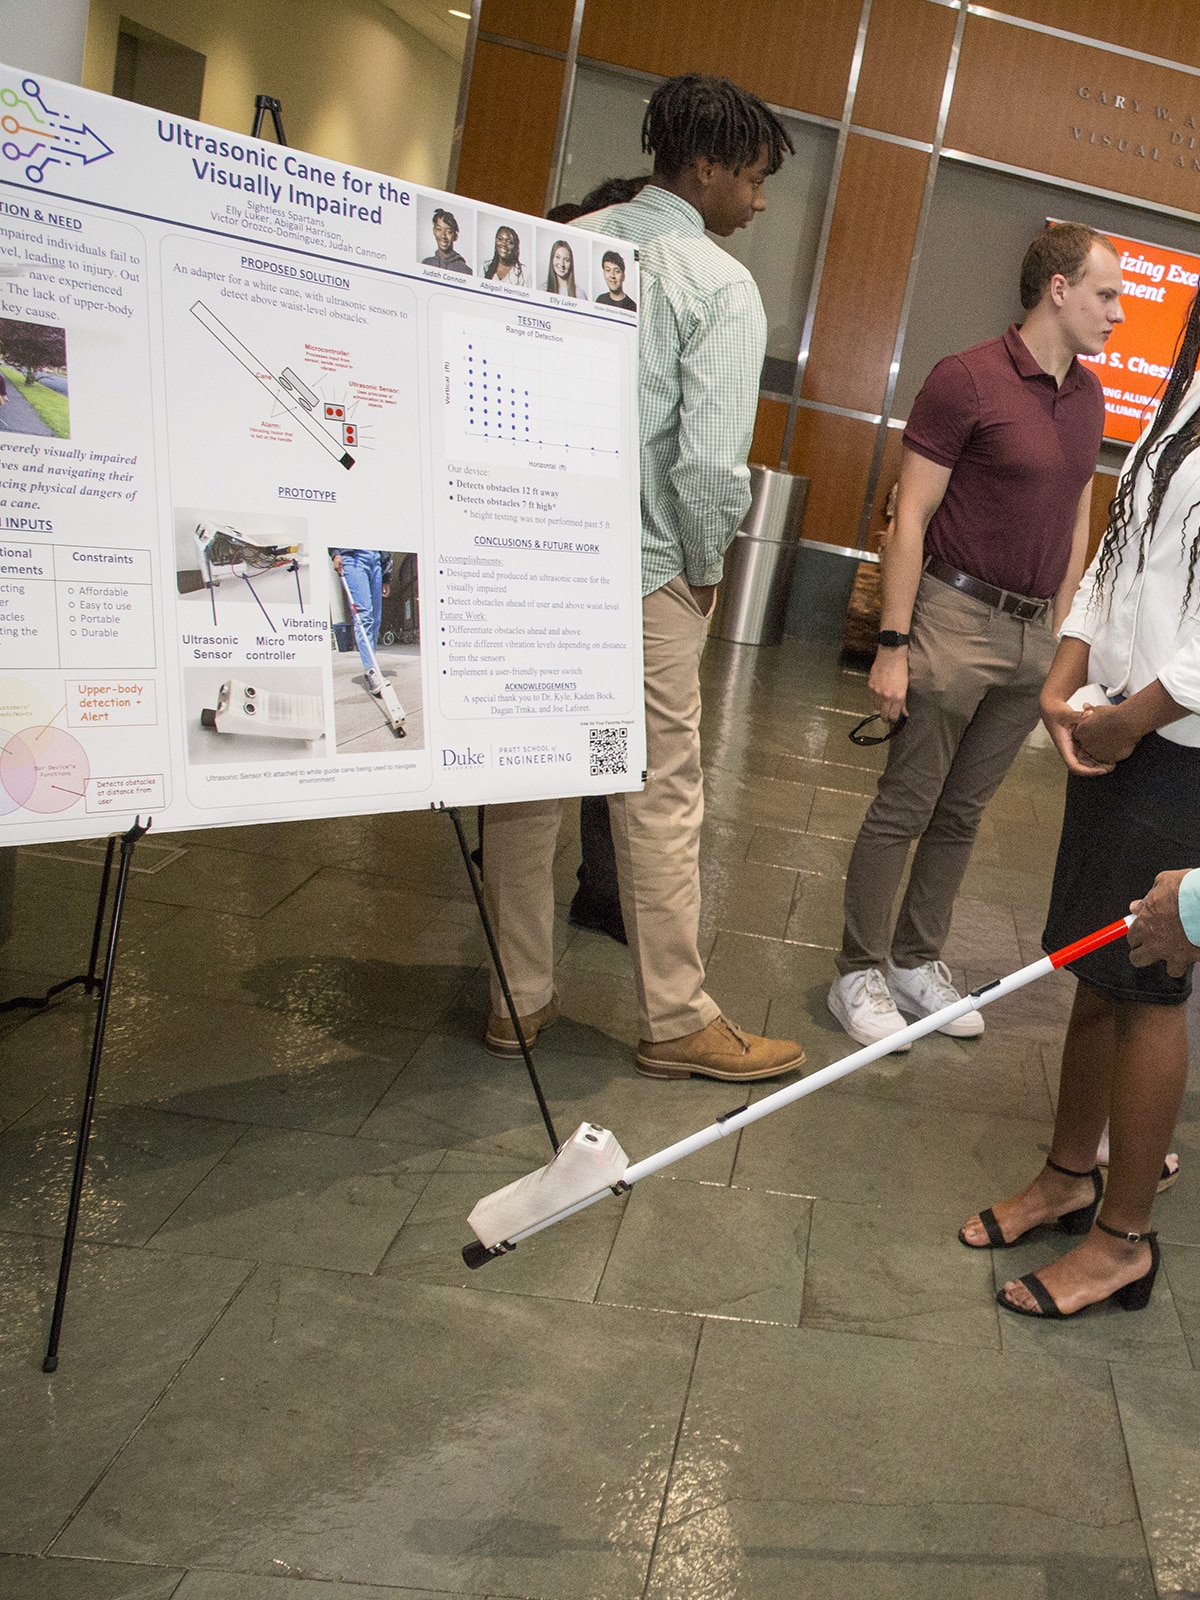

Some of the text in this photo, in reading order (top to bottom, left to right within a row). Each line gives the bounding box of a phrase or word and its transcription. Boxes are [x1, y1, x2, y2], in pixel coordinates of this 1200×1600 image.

[1078, 87, 1139, 113] GARY
[1072, 127, 1160, 161] VISUAL
[158, 119, 410, 206] Ultrasonic Cane for the
[192, 158, 382, 225] Visually Impaired
[34, 209, 45, 222] &
[48, 213, 83, 230] NEED
[226, 205, 242, 219] Elly
[275, 216, 303, 232] Abigail
[246, 200, 325, 228] Sightless Spartans
[211, 211, 238, 226] Victor
[328, 239, 354, 254] Judah
[355, 246, 387, 261] Cannon
[47, 235, 107, 258] individuals
[110, 249, 127, 262] fail
[129, 255, 140, 265] to
[25, 249, 65, 270] leading
[69, 260, 80, 270] to
[83, 261, 117, 279] injury.
[120, 269, 140, 282] Out
[240, 256, 351, 289] PROPOSED SOLUTION
[422, 268, 467, 285] Judah Cannon
[58, 276, 123, 297] experienced
[174, 263, 188, 274] An
[191, 266, 226, 282] adapter
[228, 274, 243, 285] for
[244, 279, 251, 287] a
[253, 281, 277, 294] white
[305, 292, 324, 303] with
[326, 295, 367, 312] ultrasonic
[369, 304, 399, 318] sensors
[400, 311, 409, 320] to
[480, 281, 530, 299] Abigail Harrison
[7, 282, 134, 318] The lack of upper-body
[220, 287, 248, 302] detect
[251, 294, 278, 307] above
[280, 300, 327, 317] waist-level
[550, 296, 578, 309] Elly Luker
[2, 300, 60, 321] key cause.
[517, 315, 552, 330] TESTING
[506, 325, 564, 343] Range of Detection
[1108, 352, 1124, 369] S.
[255, 372, 272, 381] Cane
[349, 380, 378, 391] Ultrasonic
[0, 443, 138, 465] everely visually impaired
[22, 463, 134, 482] and navigating their
[448, 463, 462, 474] Our
[29, 481, 77, 495] physical
[79, 486, 123, 499] dangers
[125, 490, 138, 502] of
[278, 486, 337, 501] PROTOTYPE
[456, 480, 559, 499] Detects obstacles 12 ft away
[10, 500, 41, 510] cane.
[457, 494, 485, 505] Detects
[486, 498, 521, 509] obstacles
[522, 500, 527, 508] 7
[529, 501, 535, 509] ft
[5, 517, 53, 531] INPUTS
[474, 536, 600, 553] CONCLUSIONS & FUTURE WORK
[72, 551, 134, 564] Constraints
[79, 587, 129, 597] Affordable
[80, 600, 132, 611] Easy to use
[80, 614, 121, 624] Portable
[282, 618, 328, 631] Vibrating
[21, 627, 38, 637] the
[81, 628, 119, 638] Durable
[182, 634, 239, 645] Ultrasonic
[288, 633, 324, 642] motors
[256, 636, 285, 646] Micro
[194, 649, 233, 660] Sensor
[246, 651, 296, 661] controller
[78, 684, 144, 697] Upper-body
[505, 682, 577, 691] ACKNOWLEDGEMENTS
[79, 697, 131, 708] detection
[80, 712, 110, 722] Alert
[522, 745, 550, 753] SCHOOL
[441, 747, 485, 767] Duke
[499, 752, 573, 766] ENGINEERING
[97, 778, 156, 789] Detects obstacles
[106, 787, 135, 796] distance
[136, 786, 152, 794] from
[98, 798, 113, 806] user
